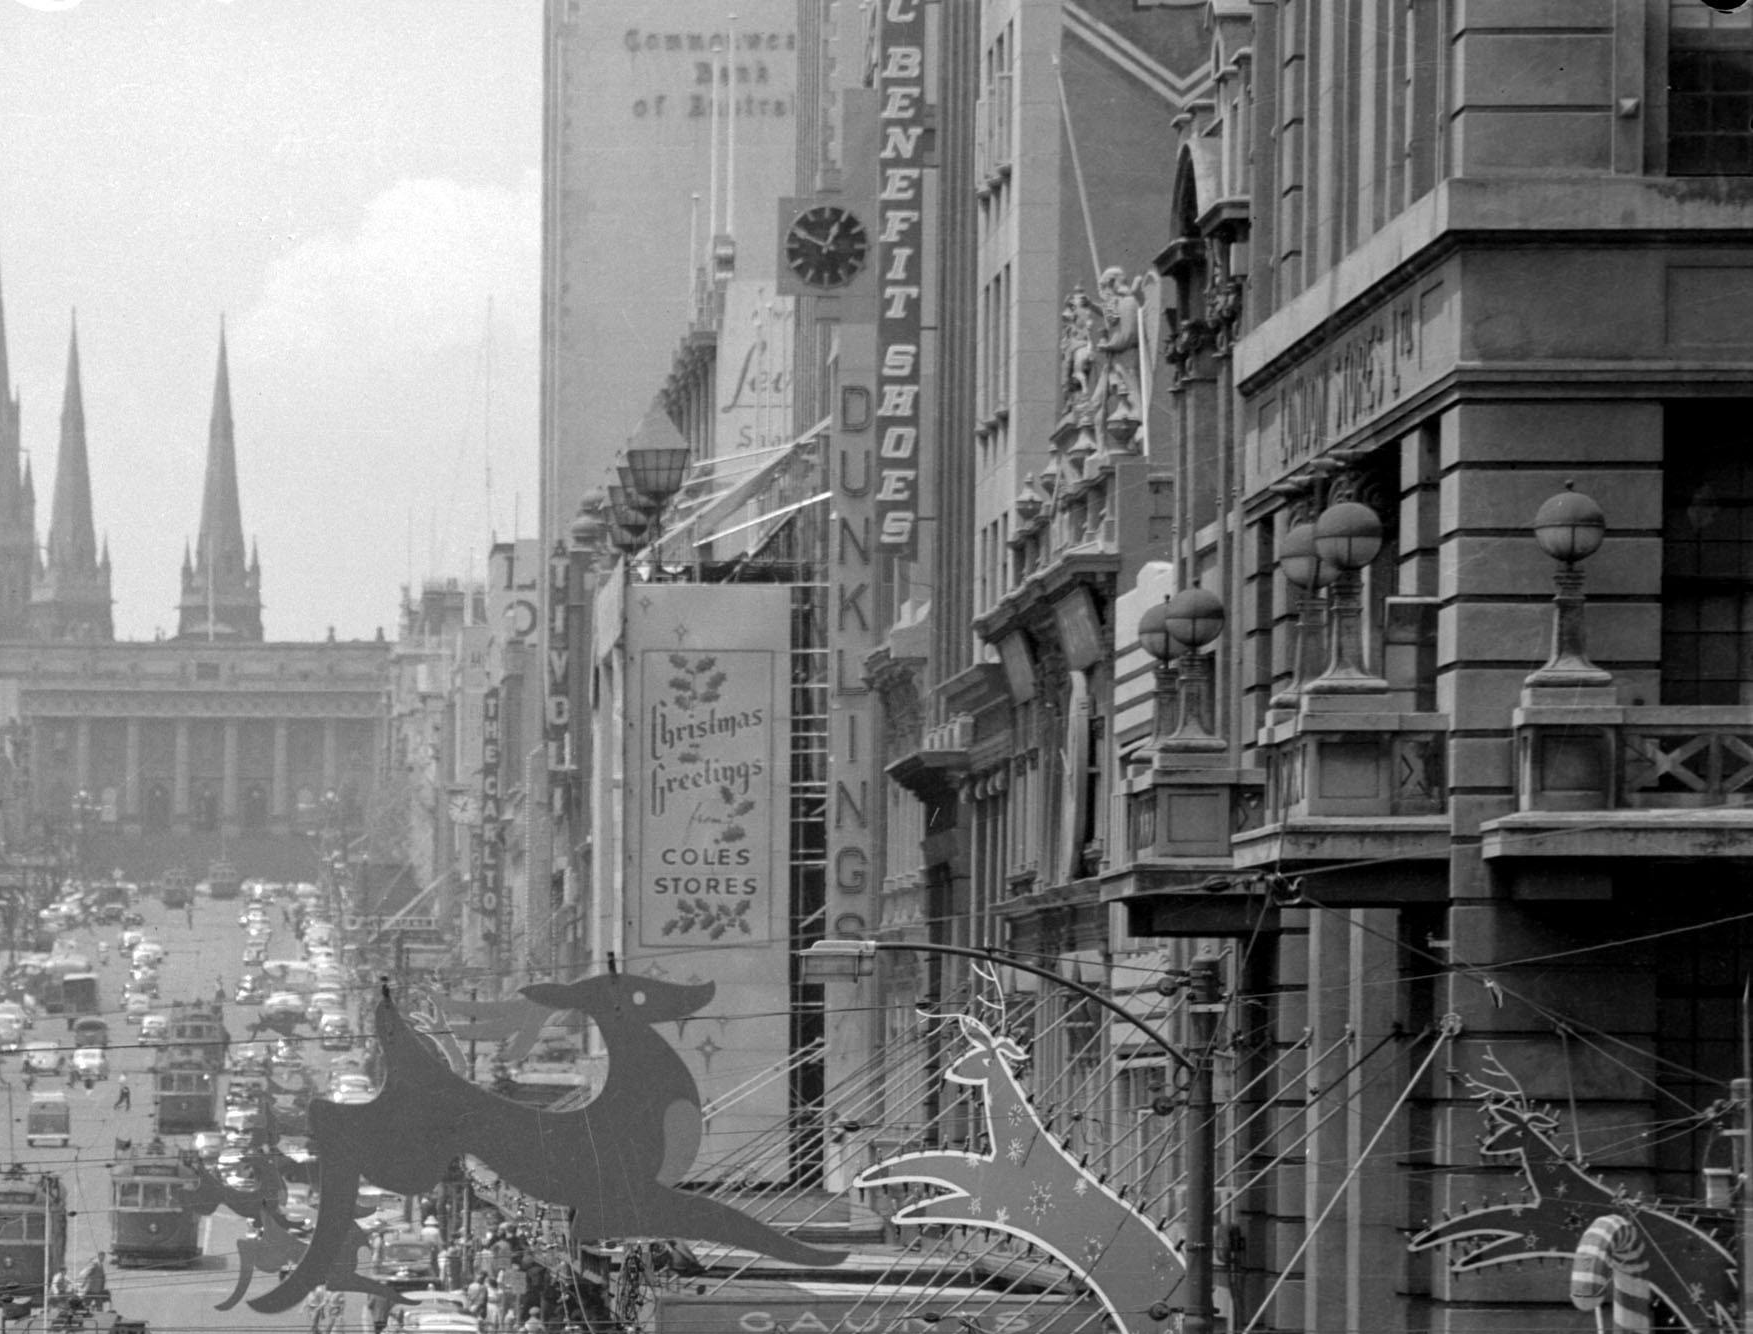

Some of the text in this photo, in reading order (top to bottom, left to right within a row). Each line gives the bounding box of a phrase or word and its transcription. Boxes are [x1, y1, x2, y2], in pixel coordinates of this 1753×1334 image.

[632, 94, 666, 118] of
[878, 46, 922, 319] BENEFIT
[874, 343, 919, 544] SHOES
[549, 556, 570, 818] TIVOLI
[832, 383, 873, 942] DUNKLINGS
[650, 700, 764, 761] Christmas
[650, 757, 764, 817] Greetings
[483, 776, 498, 932] CARLTON
[654, 877, 758, 896] STORES
[661, 848, 751, 866] COLES
